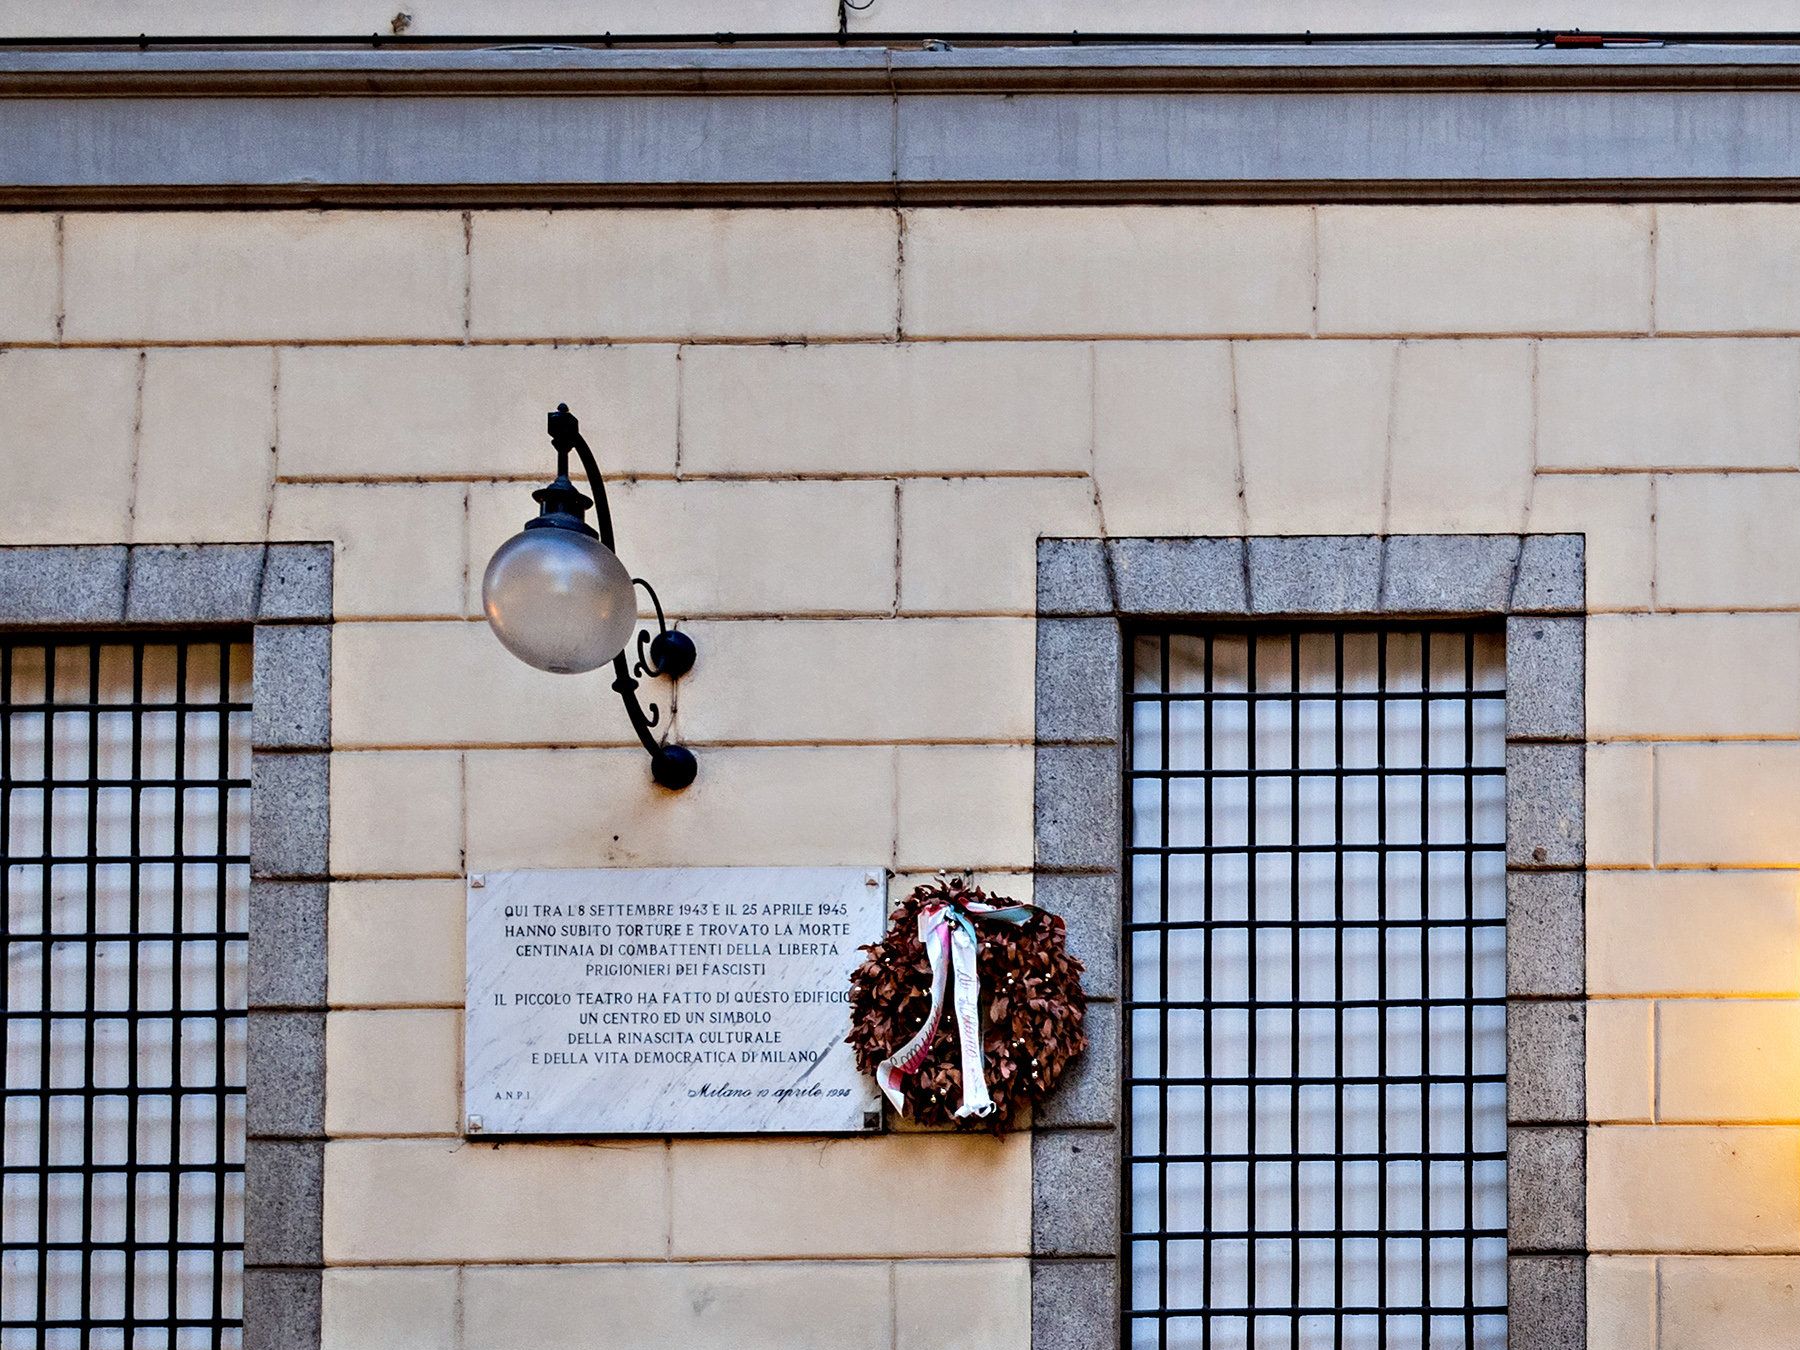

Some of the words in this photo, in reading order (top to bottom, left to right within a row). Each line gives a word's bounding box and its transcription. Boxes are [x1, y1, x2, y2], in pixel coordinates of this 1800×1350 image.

[505, 905, 528, 918] QUI
[533, 905, 562, 917] TRA
[590, 904, 674, 916] SETTEMBRE
[679, 904, 708, 916] 1943
[713, 904, 720, 916] E
[725, 904, 737, 916] IL
[742, 904, 757, 916] 25
[762, 904, 813, 916] APRILE
[818, 904, 847, 916] 1945
[505, 925, 556, 937] HANNO
[561, 925, 611, 937] SUBITO
[616, 924, 681, 937] TORTURE
[686, 924, 694, 936] E
[700, 924, 769, 936] TROVATO
[775, 924, 793, 936] LA
[799, 924, 850, 936] MORTE
[516, 944, 594, 957] CENTINAIA
[600, 944, 613, 956] DI
[618, 944, 721, 956] COMBATTENTI
[727, 943, 771, 955] DELLA
[586, 964, 670, 976] PRIGIONIERI
[676, 964, 697, 976] DEI
[702, 964, 766, 976] FASCISTI
[494, 994, 507, 1006] IL
[515, 993, 571, 1005] PICCOLO
[576, 993, 633, 1005] TEATRO
[638, 992, 658, 1004] HA
[663, 992, 712, 1004] FATTO
[716, 992, 730, 1004] DI
[734, 991, 789, 1003] QUESTO
[579, 1013, 598, 1024] UN
[603, 1012, 659, 1024] CENTRO
[663, 1012, 681, 1024] ED
[685, 1012, 705, 1024] UN
[709, 1012, 771, 1024] SIMBOLO
[568, 1033, 612, 1044] DELLA
[618, 1032, 694, 1044] RINASCITA
[700, 1032, 782, 1043] CULTURALE
[532, 1053, 539, 1064] E
[544, 1053, 588, 1064] DELLA
[594, 1052, 629, 1064] VITA
[634, 1052, 736, 1064] DEMOCRATICA
[741, 1052, 755, 1063] DI
[760, 1051, 818, 1063] MILANO
[688, 1082, 751, 1098] Milano
[772, 1082, 822, 1103] aprile
